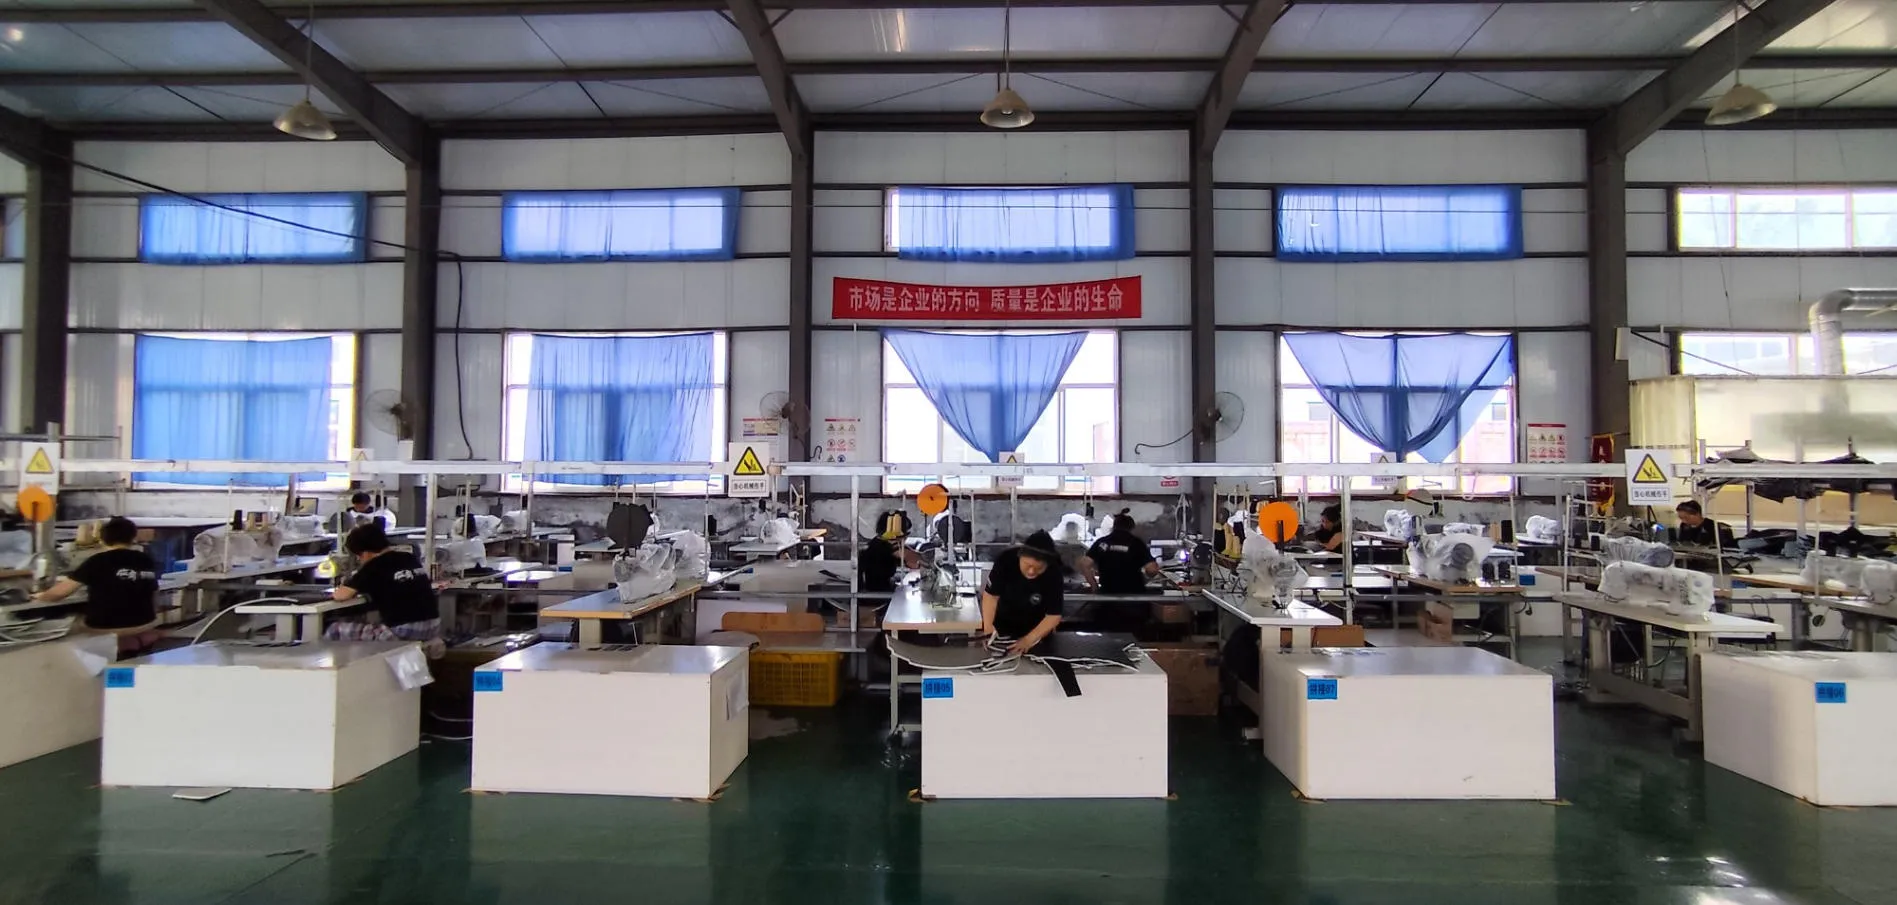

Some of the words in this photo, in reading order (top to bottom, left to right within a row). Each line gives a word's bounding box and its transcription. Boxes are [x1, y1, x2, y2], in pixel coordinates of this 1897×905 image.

[849, 285, 980, 312] 市场是企业的方向
[991, 283, 1123, 312] 质量是企业的生命
